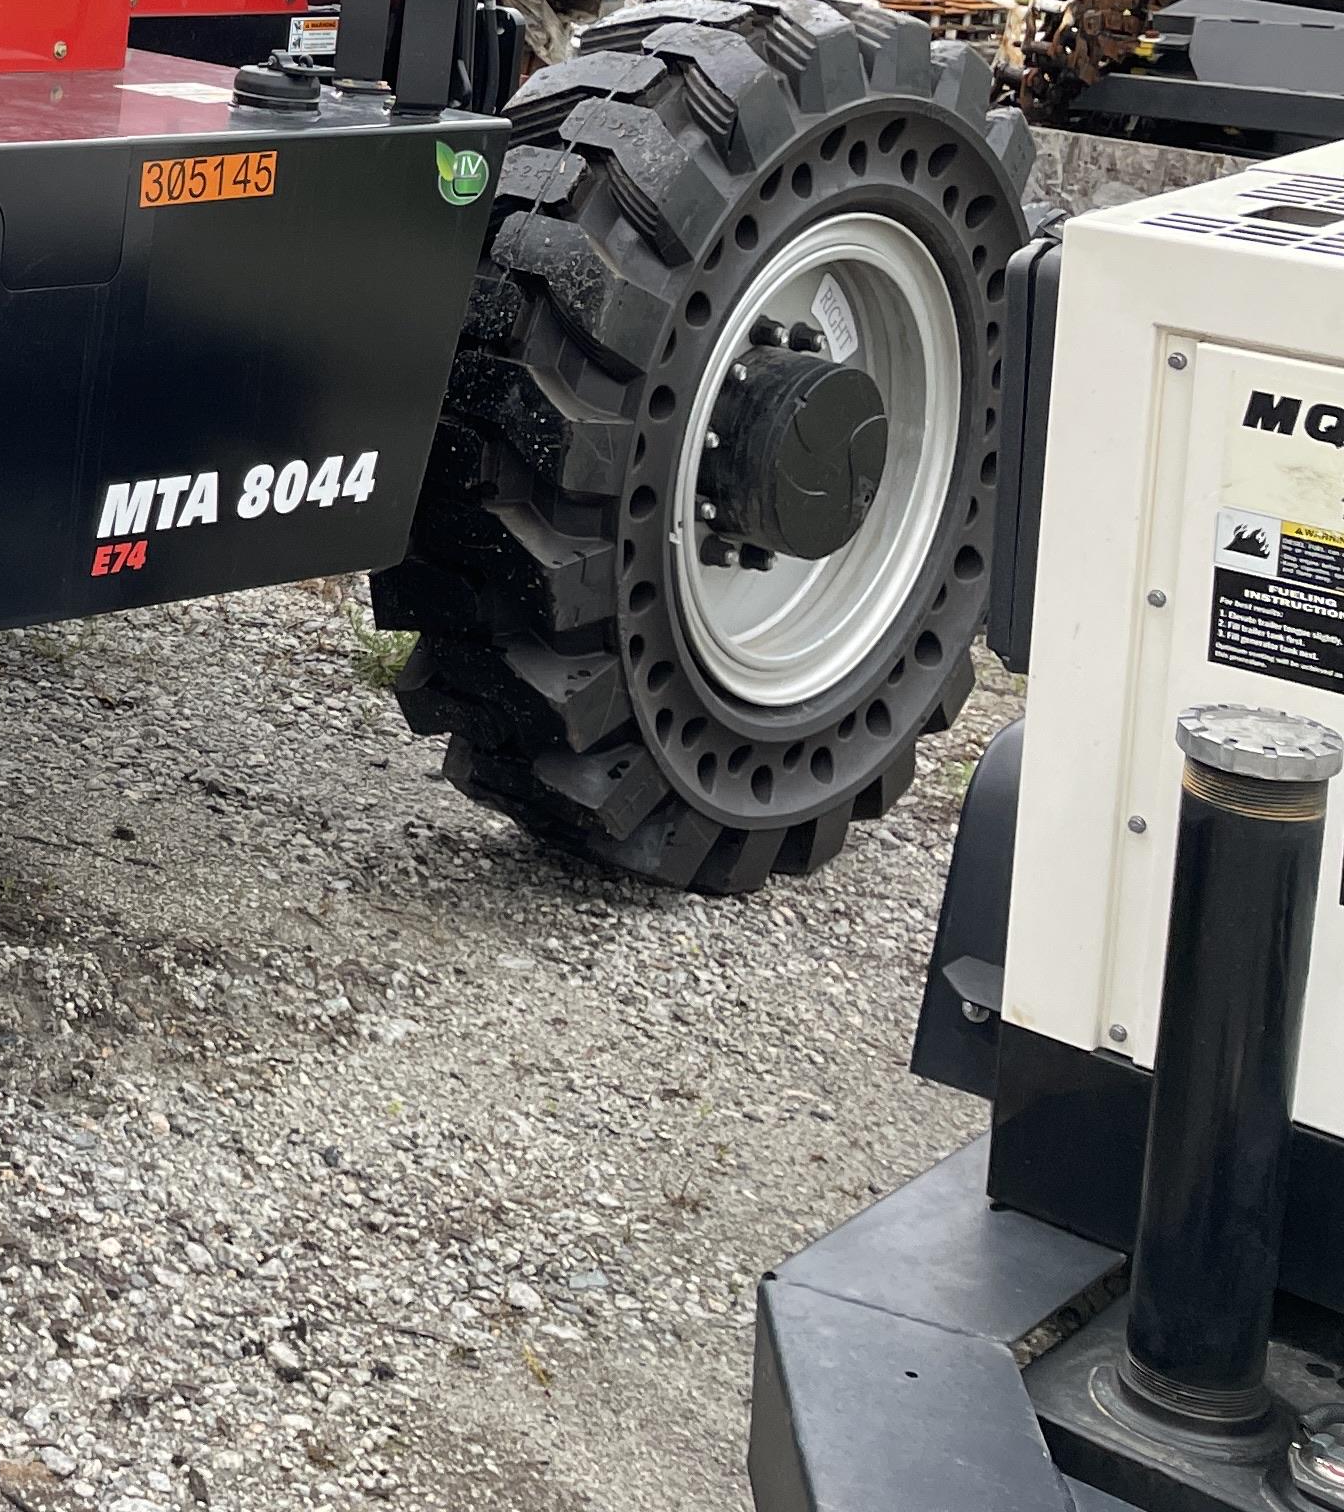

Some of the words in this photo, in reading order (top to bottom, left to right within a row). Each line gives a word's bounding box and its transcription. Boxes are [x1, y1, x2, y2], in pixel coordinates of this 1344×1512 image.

[145, 153, 273, 203] 305145
[820, 287, 852, 352] RIGHT
[96, 471, 219, 539] MTA
[236, 450, 379, 520] 8044
[90, 539, 149, 577] E74
[1268, 585, 1337, 607] FUELING
